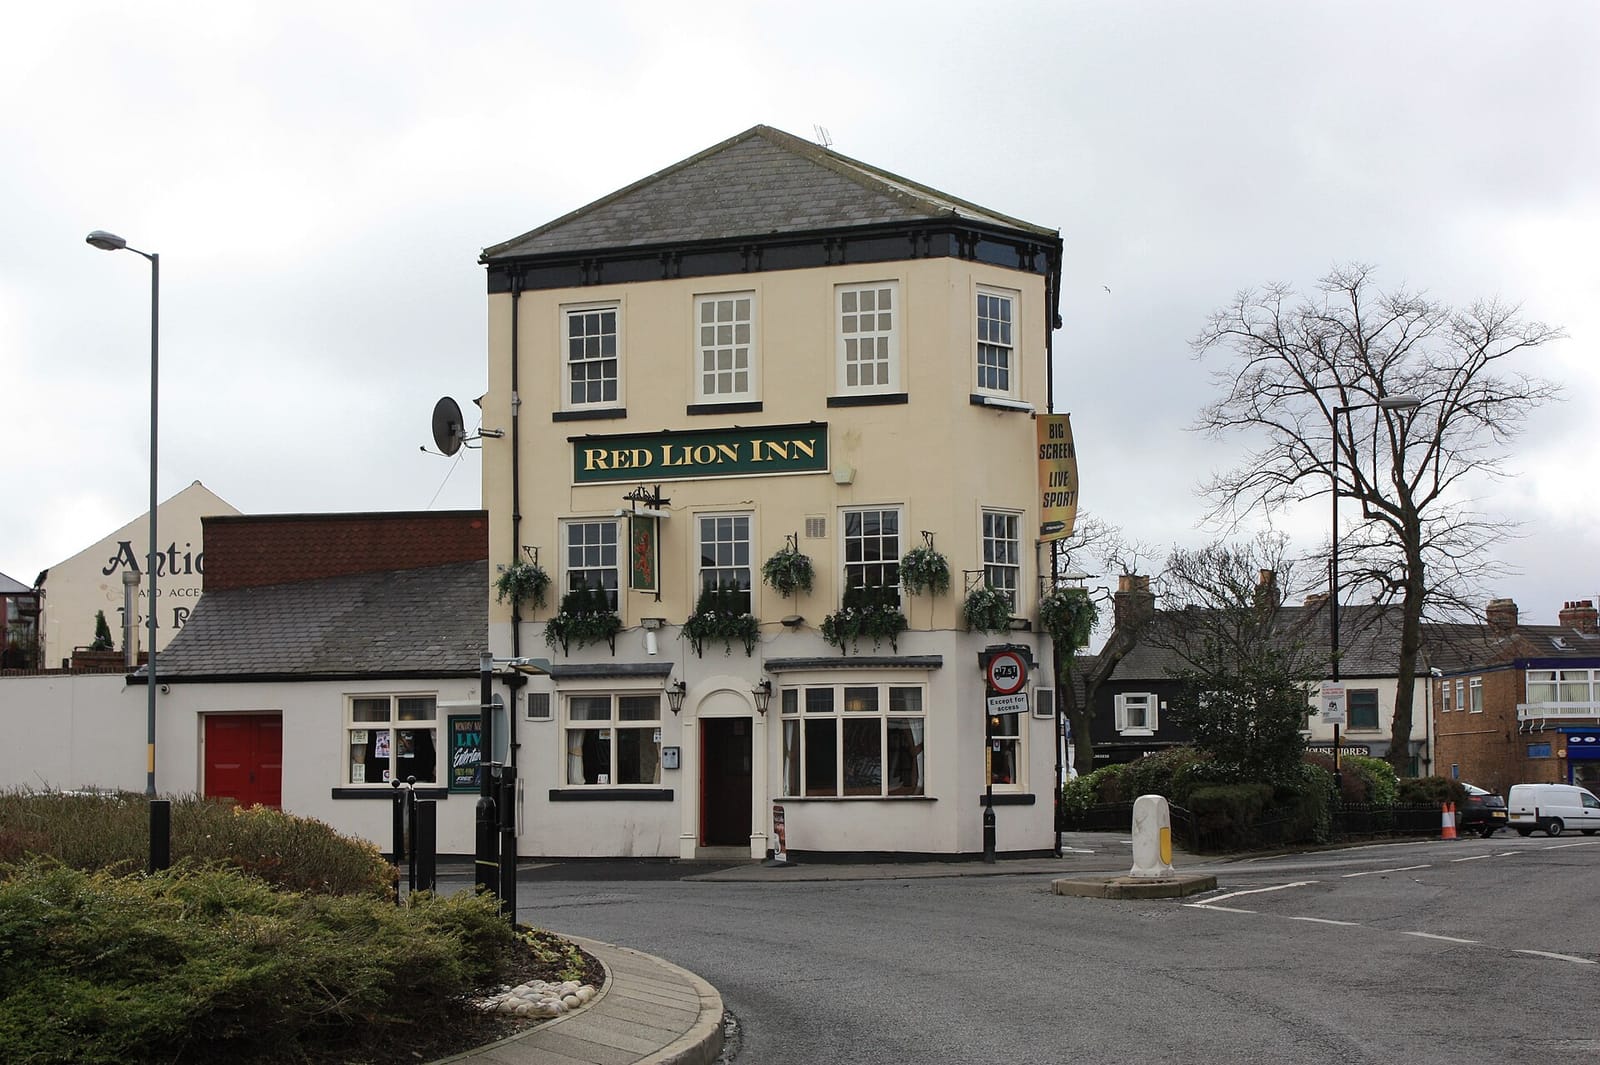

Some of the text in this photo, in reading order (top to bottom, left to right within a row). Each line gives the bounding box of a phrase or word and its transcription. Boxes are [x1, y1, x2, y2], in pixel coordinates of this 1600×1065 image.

[1049, 423, 1064, 439] BIG
[584, 439, 816, 471] RED LION INN
[1039, 442, 1075, 460] SCREEN
[1048, 471, 1069, 487] LIVE
[1043, 491, 1075, 508] SPORT
[138, 589, 162, 597] AD
[990, 697, 1013, 706] Except
